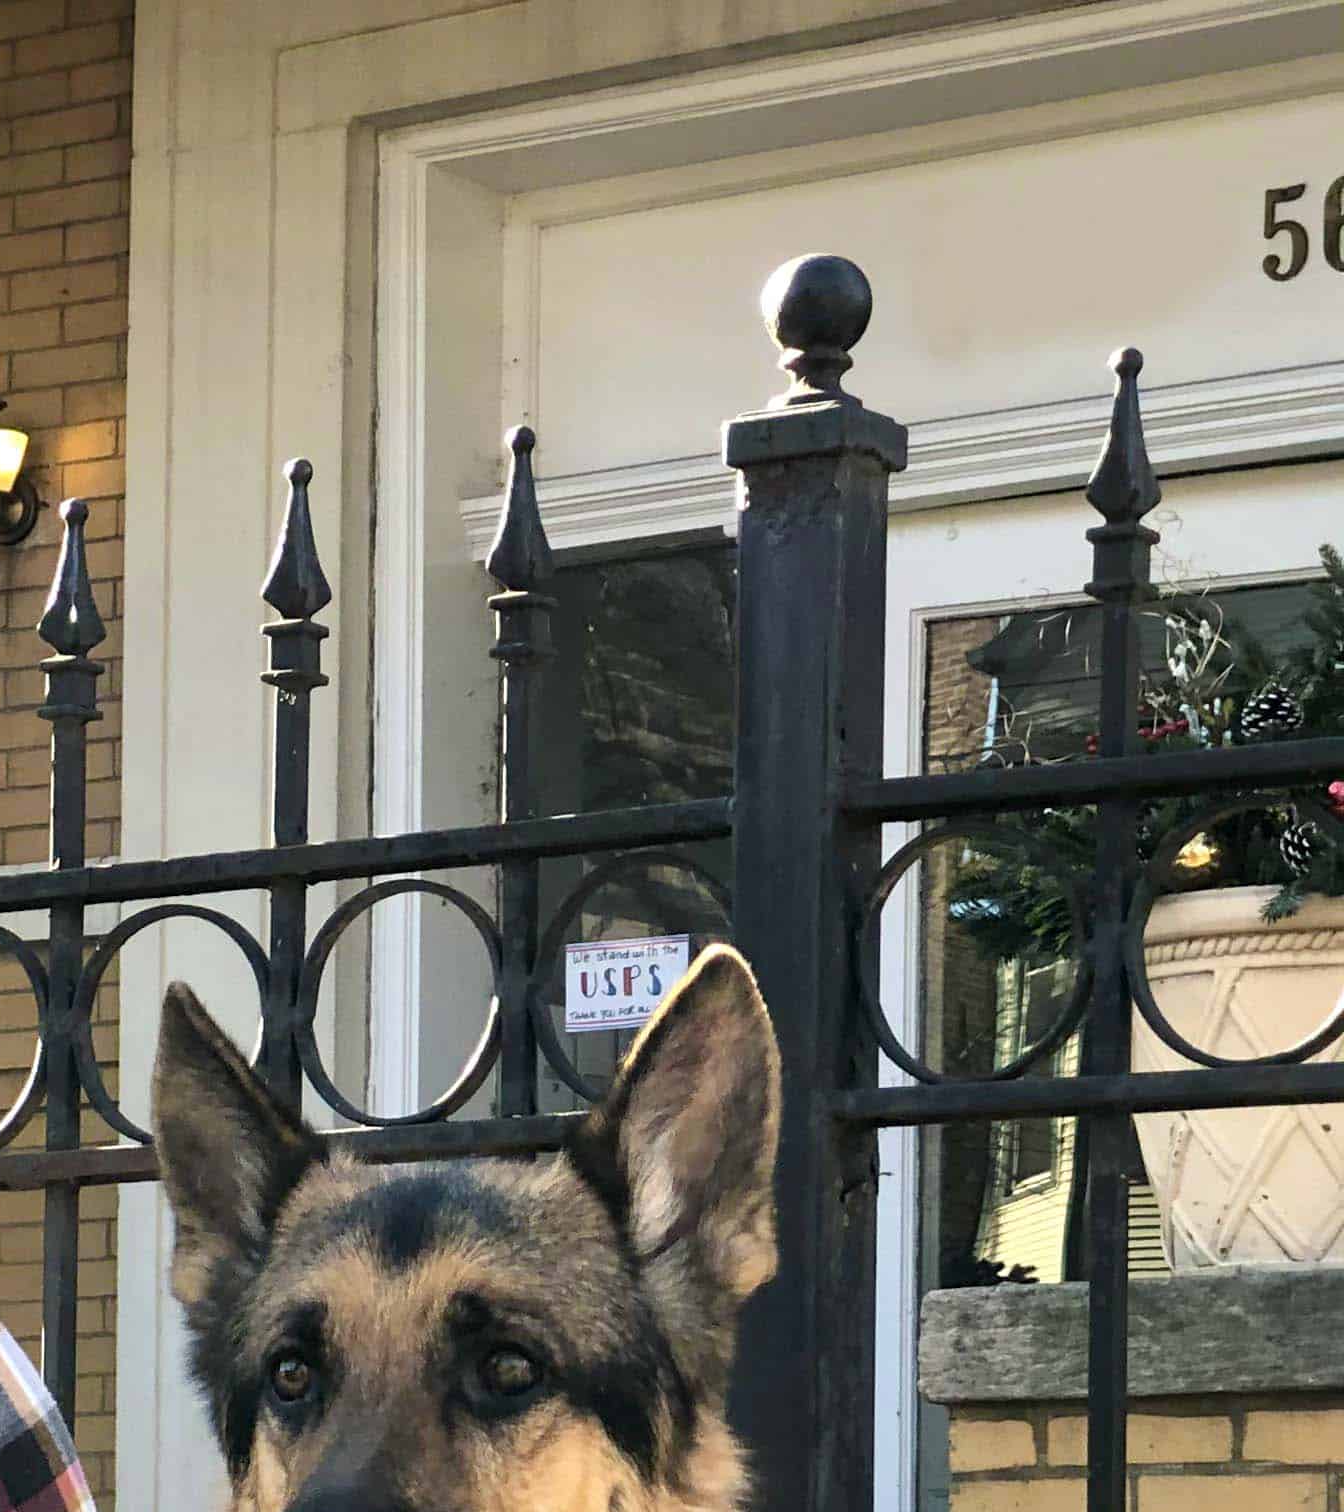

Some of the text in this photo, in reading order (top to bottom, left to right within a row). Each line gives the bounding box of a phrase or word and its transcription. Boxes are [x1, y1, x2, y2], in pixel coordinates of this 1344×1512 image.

[572, 951, 590, 964] We
[596, 949, 630, 961] stand
[632, 947, 658, 958] with
[580, 964, 662, 998] USPS
